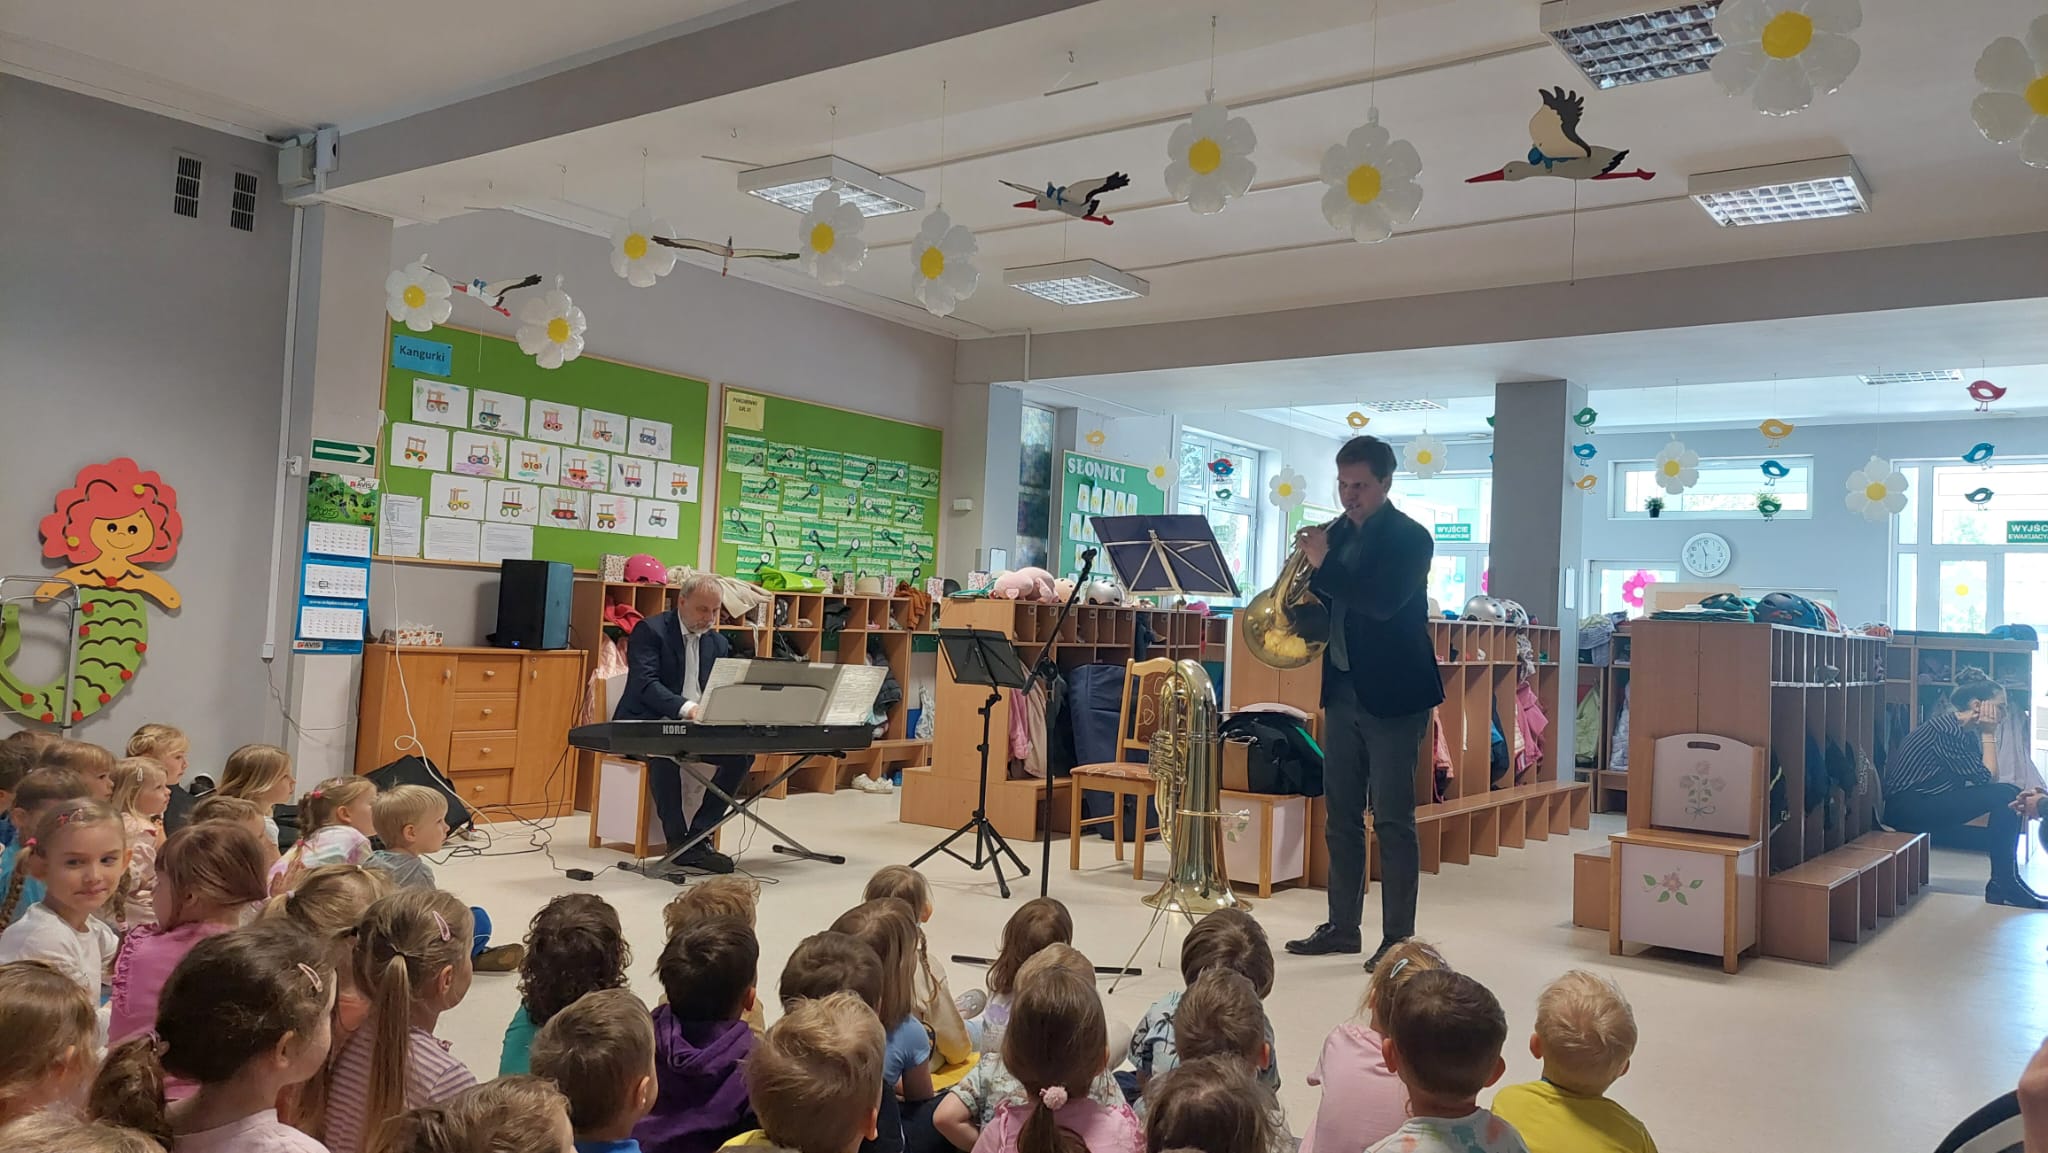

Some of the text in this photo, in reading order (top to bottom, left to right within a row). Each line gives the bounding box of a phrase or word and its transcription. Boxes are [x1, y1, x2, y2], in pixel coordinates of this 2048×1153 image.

[399, 344, 445, 362] Kangurki
[1068, 457, 1126, 484] SŁONIKI
[1437, 525, 1469, 534] WYJŚCIE
[662, 724, 687, 735] KORG
